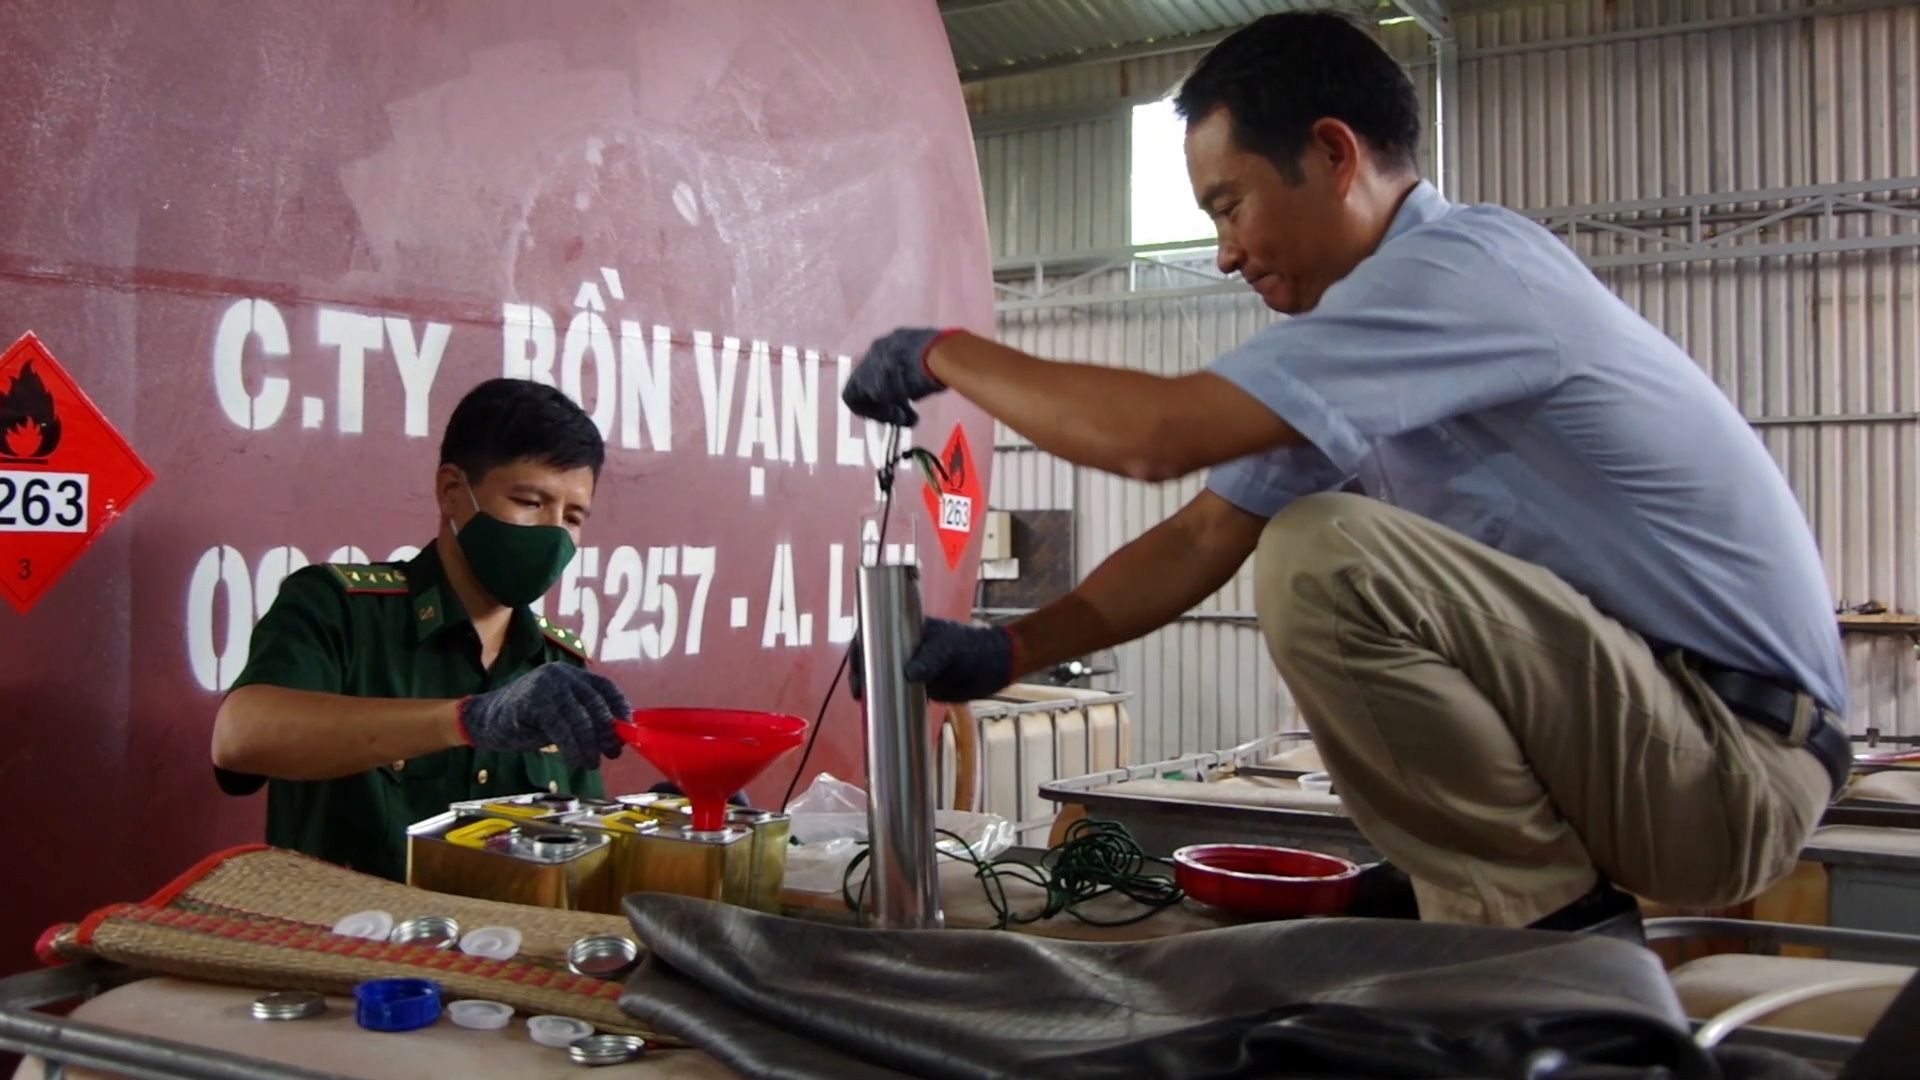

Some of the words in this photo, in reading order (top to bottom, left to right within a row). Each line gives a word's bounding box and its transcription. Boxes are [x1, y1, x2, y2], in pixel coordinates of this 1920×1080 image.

[214, 298, 452, 438] C.TY
[693, 330, 820, 497] VẠN
[941, 497, 970, 527] 1263
[17, 558, 32, 580] 3
[761, 544, 812, 648] A.
